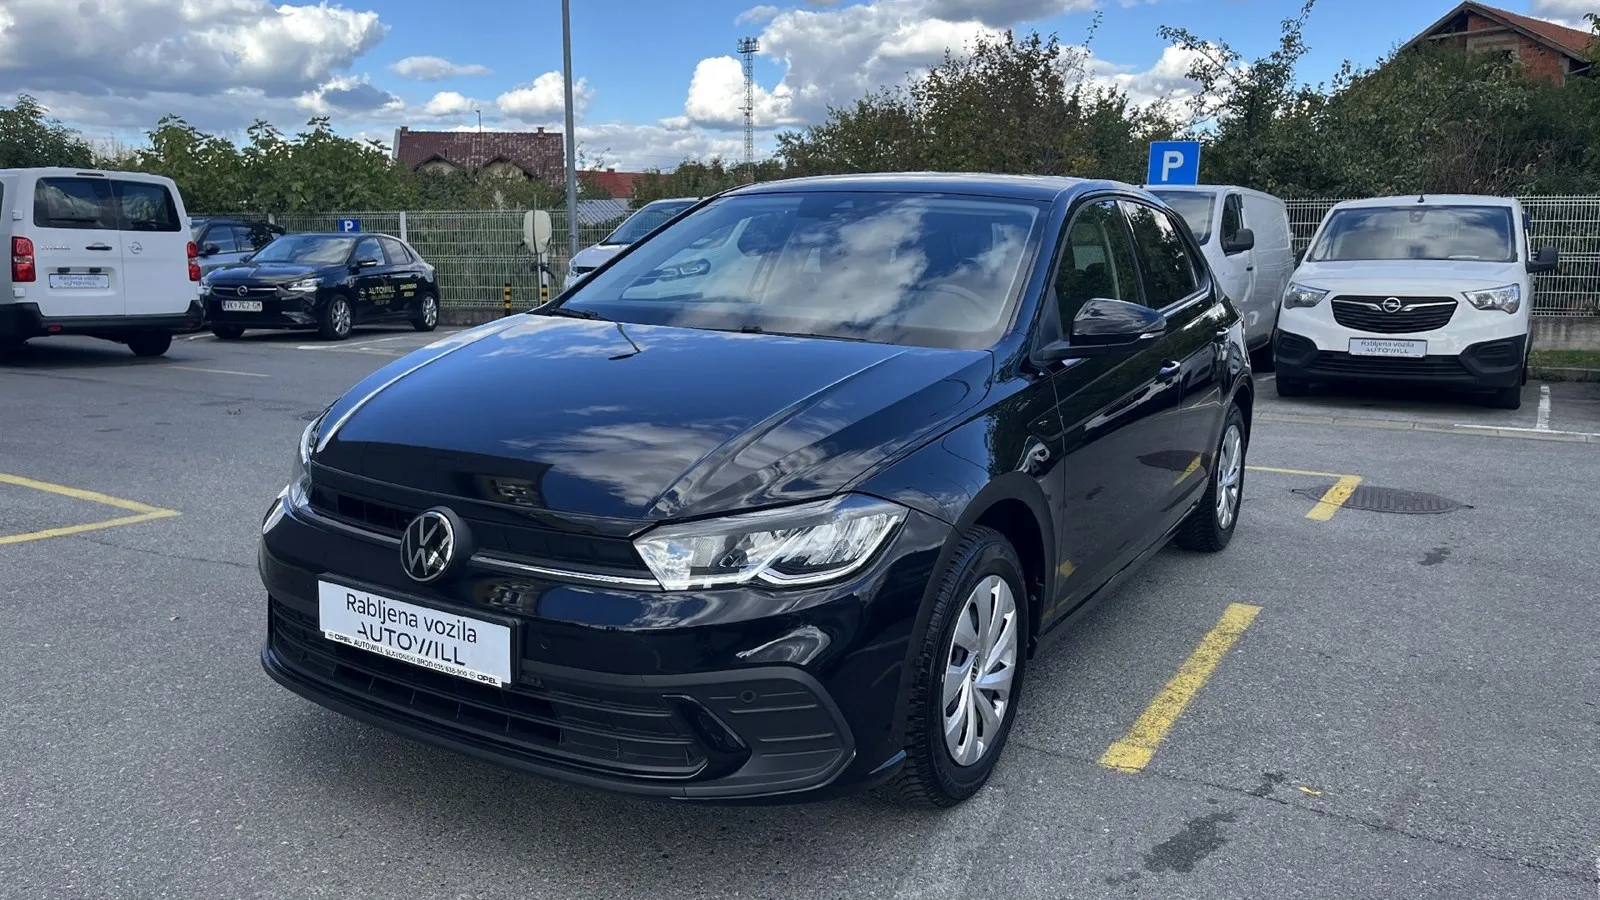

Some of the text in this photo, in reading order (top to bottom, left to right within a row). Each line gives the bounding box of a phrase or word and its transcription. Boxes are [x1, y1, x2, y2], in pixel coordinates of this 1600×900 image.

[1161, 150, 1185, 182] P
[344, 220, 354, 233] P
[346, 592, 477, 644] Rabljena vozila
[334, 633, 352, 644] OPEL
[353, 639, 384, 654] AUTOWILL
[476, 674, 499, 685] OPEL
[357, 621, 466, 666] AUTOWILL
